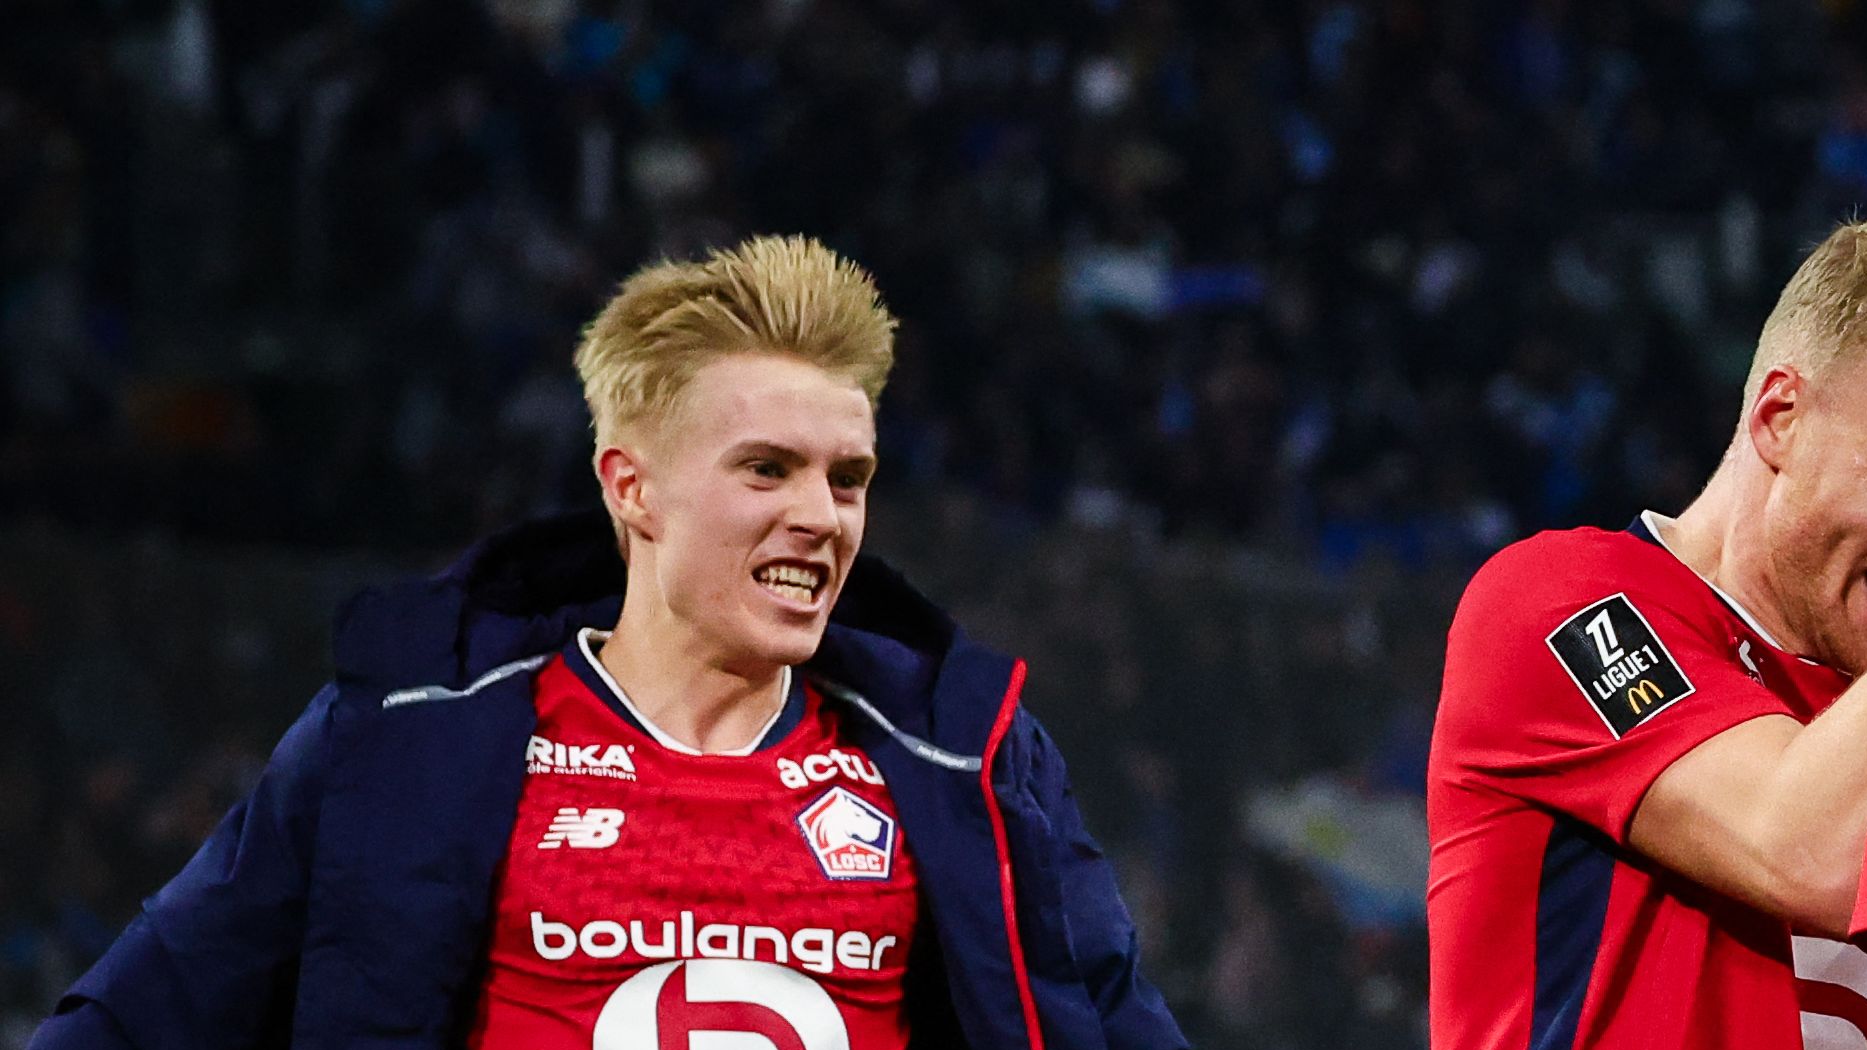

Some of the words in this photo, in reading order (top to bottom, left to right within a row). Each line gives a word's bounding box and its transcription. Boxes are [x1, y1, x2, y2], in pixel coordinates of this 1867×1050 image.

[1592, 649, 1650, 700] LIGUE
[1642, 644, 1659, 664] 1
[525, 735, 636, 773] RIKA
[777, 749, 886, 790] actu
[829, 852, 882, 871] LOSC
[529, 911, 896, 973] boulanger
